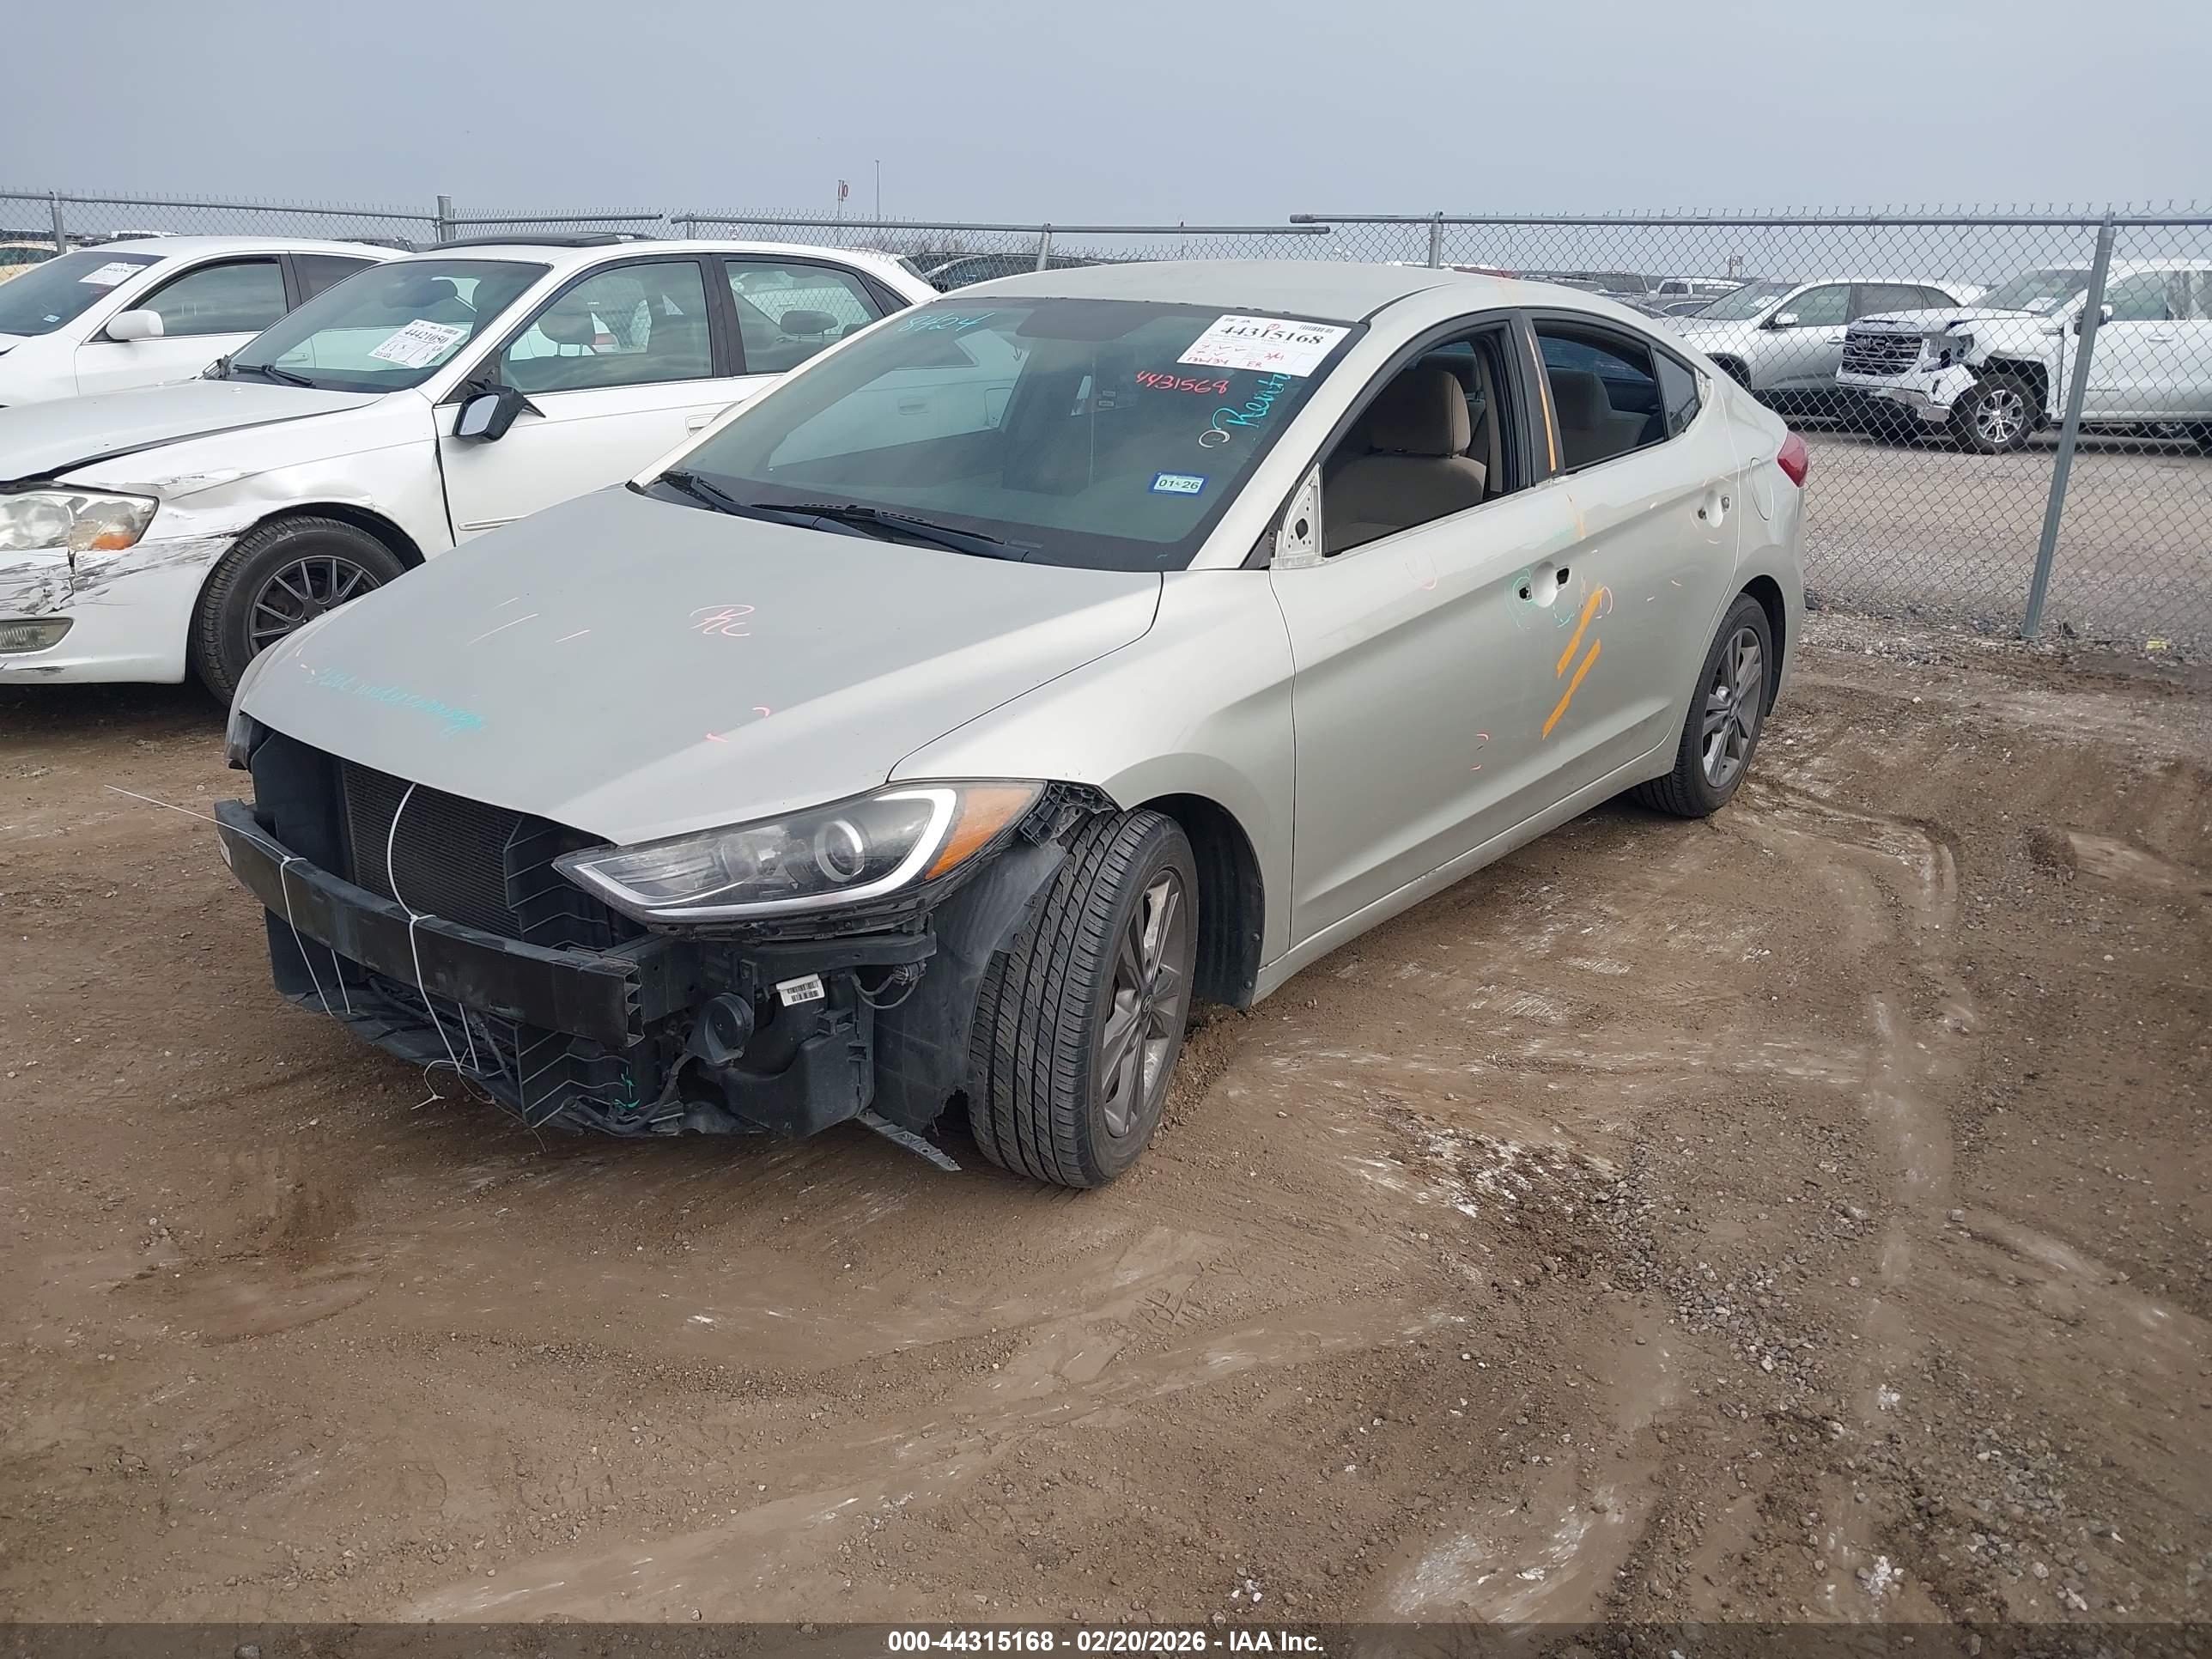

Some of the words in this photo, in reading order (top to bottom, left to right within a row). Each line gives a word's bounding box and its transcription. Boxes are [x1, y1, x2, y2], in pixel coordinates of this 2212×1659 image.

[1220, 325, 1324, 344] 44315168
[1136, 370, 1230, 395] 4431568
[1158, 479, 1175, 488] 01
[1181, 480, 1200, 489] 26
